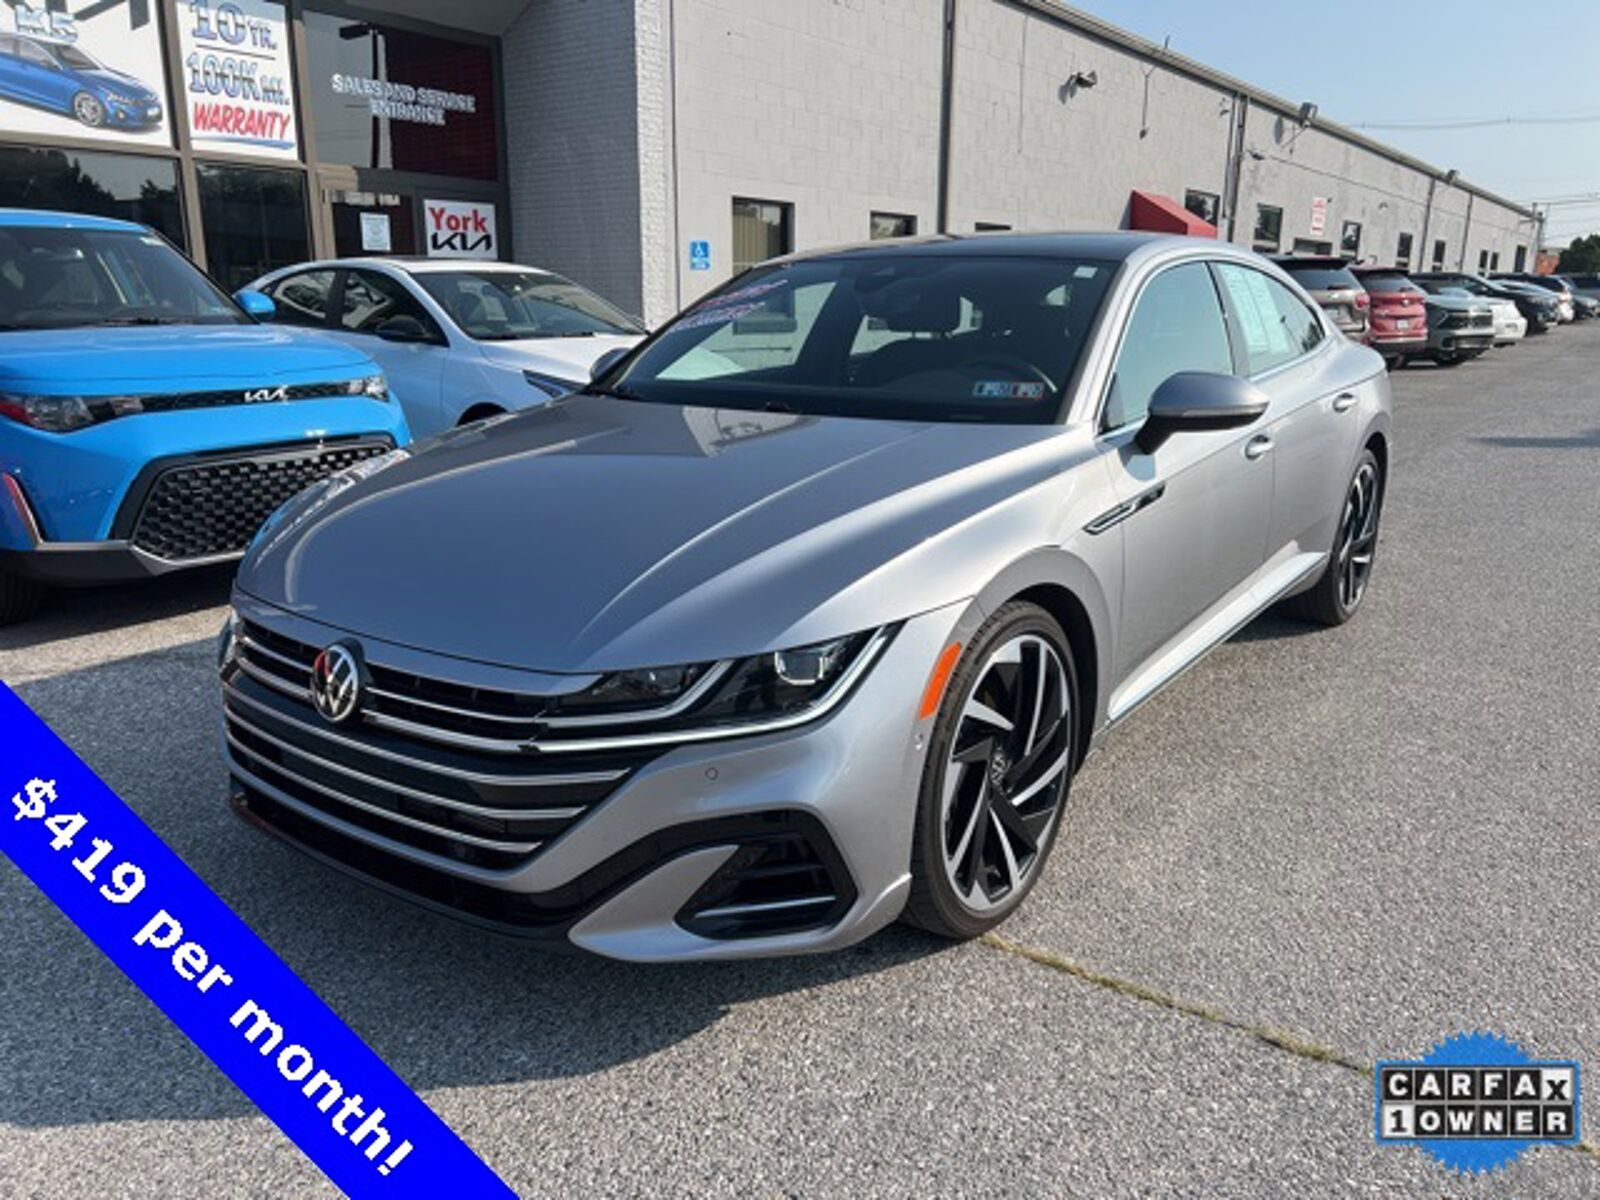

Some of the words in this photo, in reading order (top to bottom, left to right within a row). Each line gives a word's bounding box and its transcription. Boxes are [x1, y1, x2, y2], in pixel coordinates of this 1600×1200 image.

[190, 0, 246, 45] 10
[331, 73, 382, 97] SALES
[384, 82, 416, 103] AND
[417, 87, 476, 113] SERVICE
[370, 98, 446, 125] ENTRANCE
[193, 101, 290, 139] WARRANTY
[429, 207, 488, 232] York
